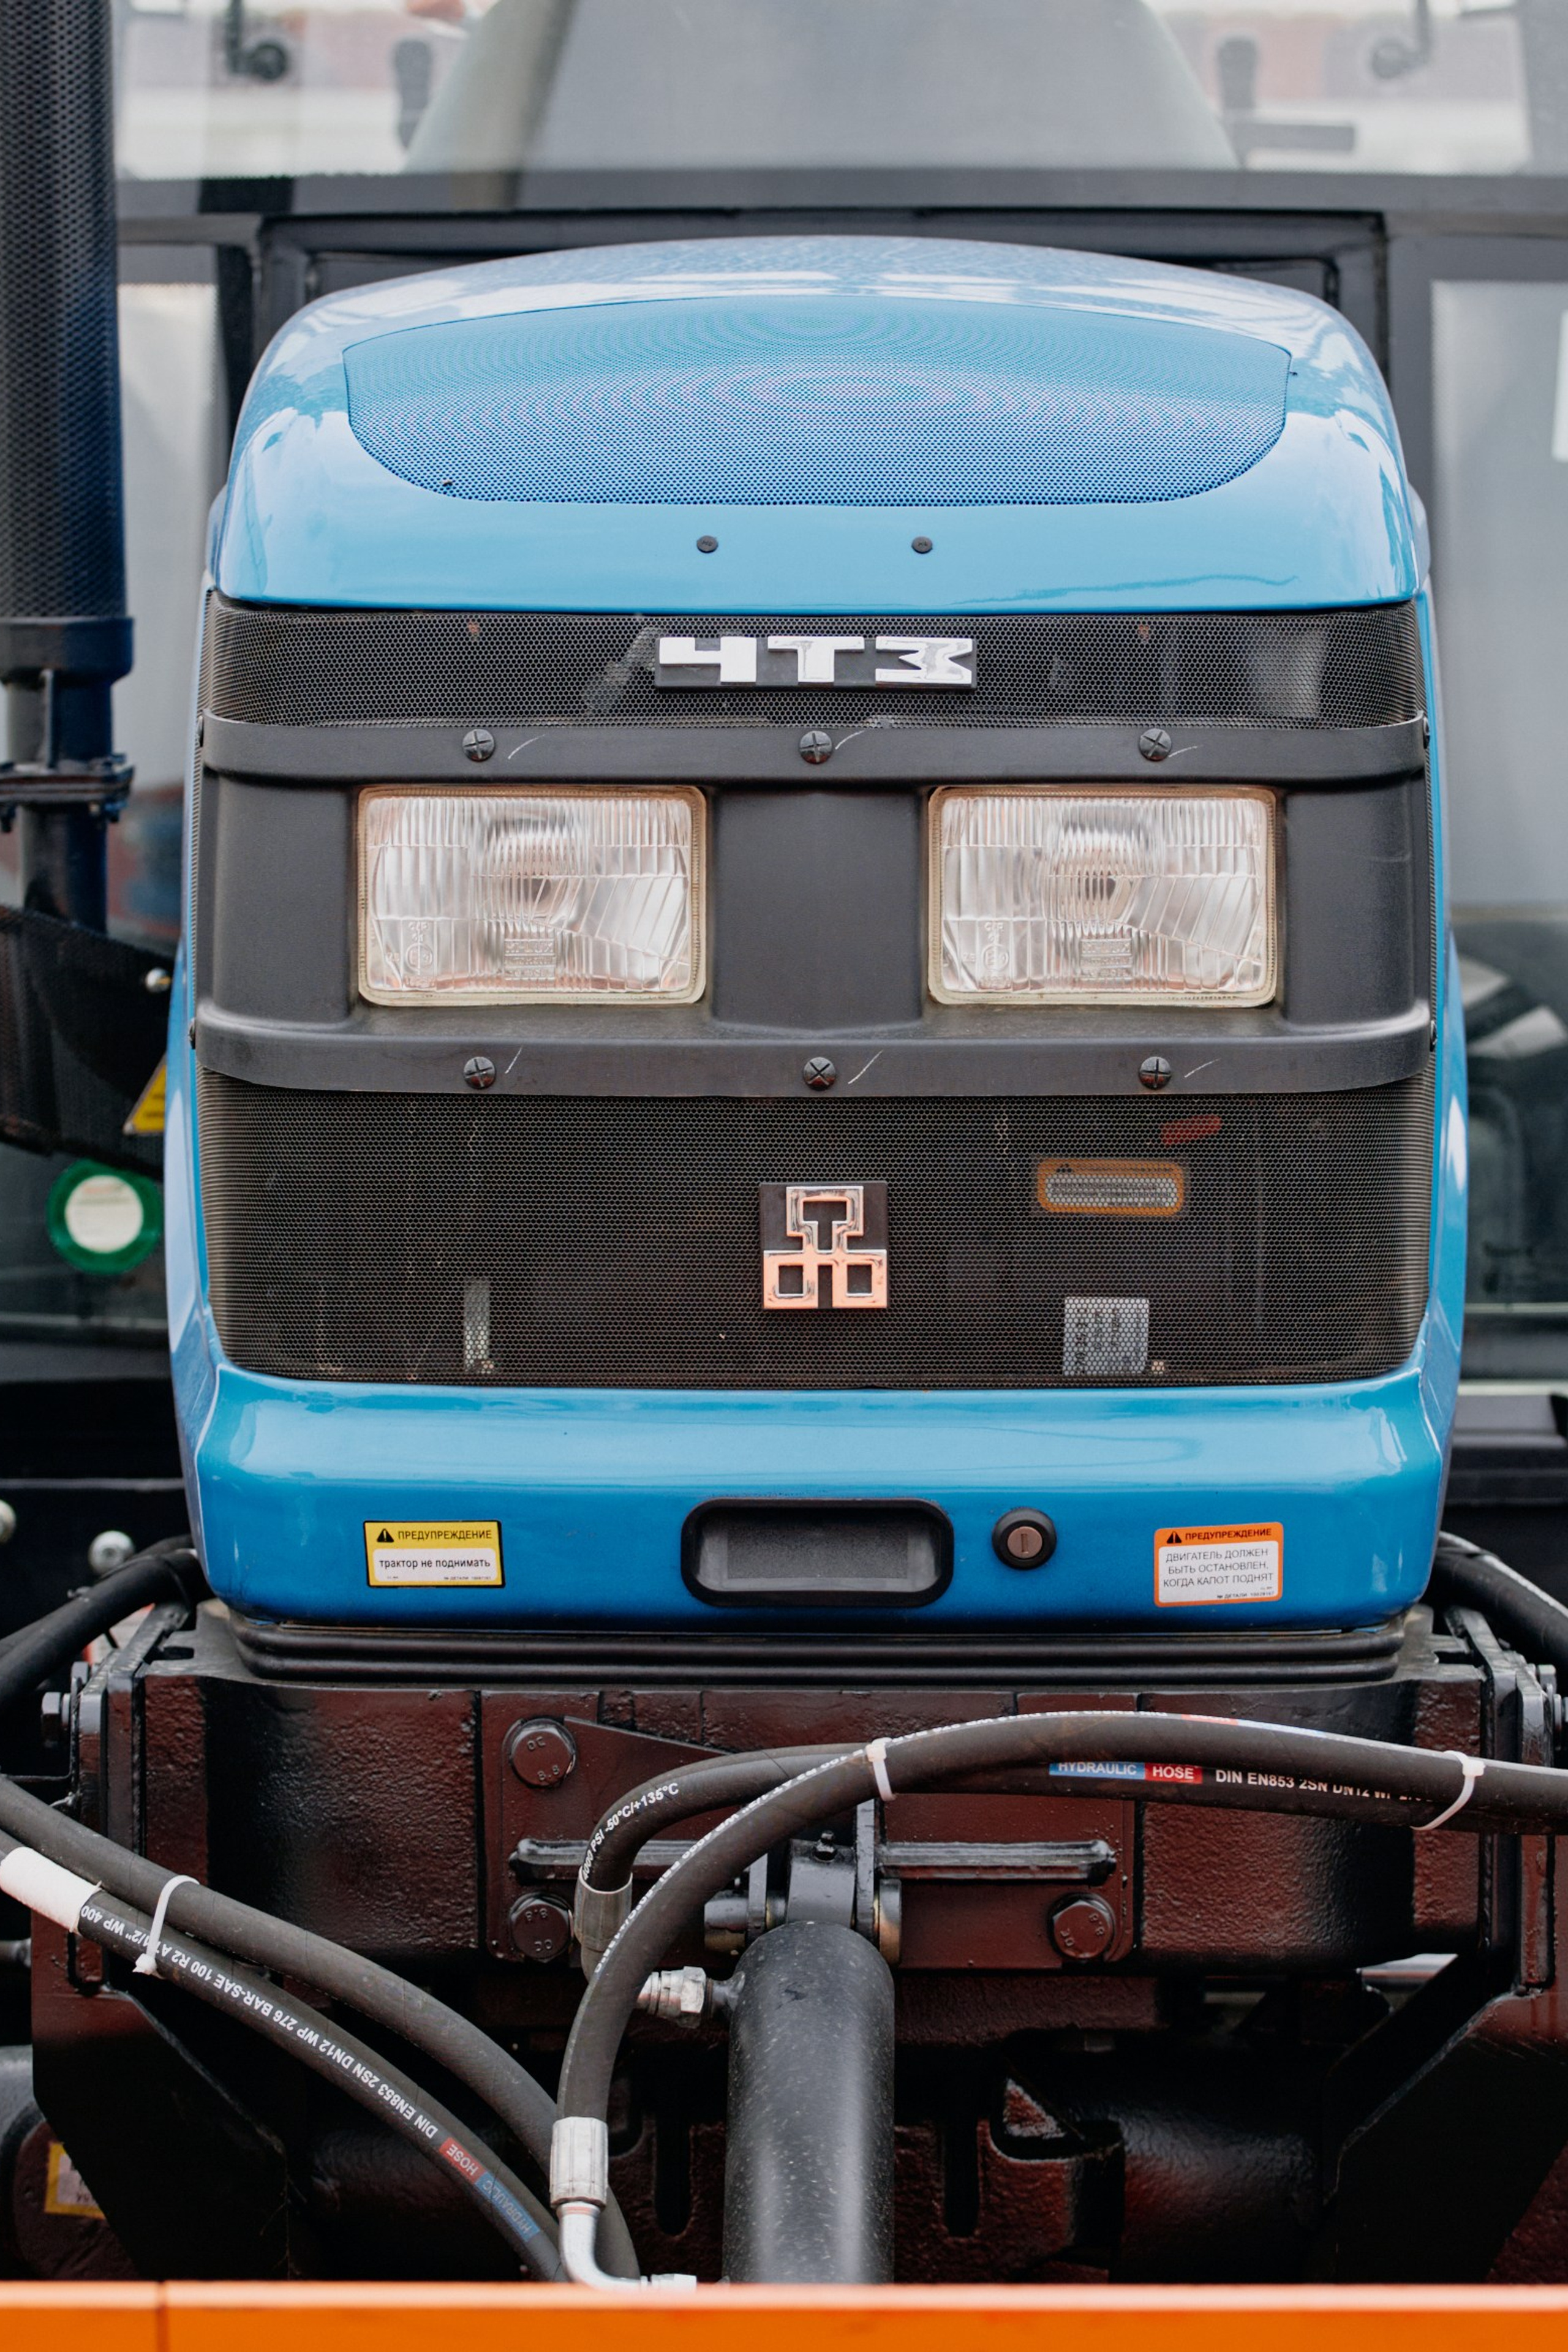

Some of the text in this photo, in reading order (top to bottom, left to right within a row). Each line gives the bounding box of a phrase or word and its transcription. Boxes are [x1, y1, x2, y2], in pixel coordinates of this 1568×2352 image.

[660, 636, 973, 685] ЧТЗ
[398, 1529, 492, 1540] ПРЕДУПРЕЖДЕНИЕ
[1185, 1528, 1272, 1541] ПРЕДУПРЕЖДЕНИЕ
[379, 1559, 491, 1570] трактор не поднимать
[1166, 1548, 1268, 1562] ДВИГАТЕЛЬ ДОЛЖЕН
[1163, 1572, 1274, 1588] КОГДА КАПОТ ПОДНЯТ
[1168, 1566, 1196, 1575] БЫТЬ
[1058, 1762, 1137, 1776] HYDRAULIC
[1153, 1766, 1195, 1781] HOSE
[1215, 1769, 1242, 1784] DIN
[1247, 1772, 1295, 1788] EN853
[590, 1829, 605, 1852] PSI
[103, 1919, 125, 1936] WP
[172, 1951, 191, 1973] R2
[190, 1962, 213, 1981] 100
[213, 1973, 274, 2018] BAR-SAE
[273, 2010, 298, 2030] 276
[296, 2026, 320, 2046] WP
[318, 2038, 355, 2070] DN12
[352, 2062, 380, 2088] 2SN
[377, 2083, 417, 2120] EN853
[414, 2115, 439, 2139] DIN
[446, 2144, 479, 2177] HOSE
[482, 2179, 533, 2235] HYDRAULIC
